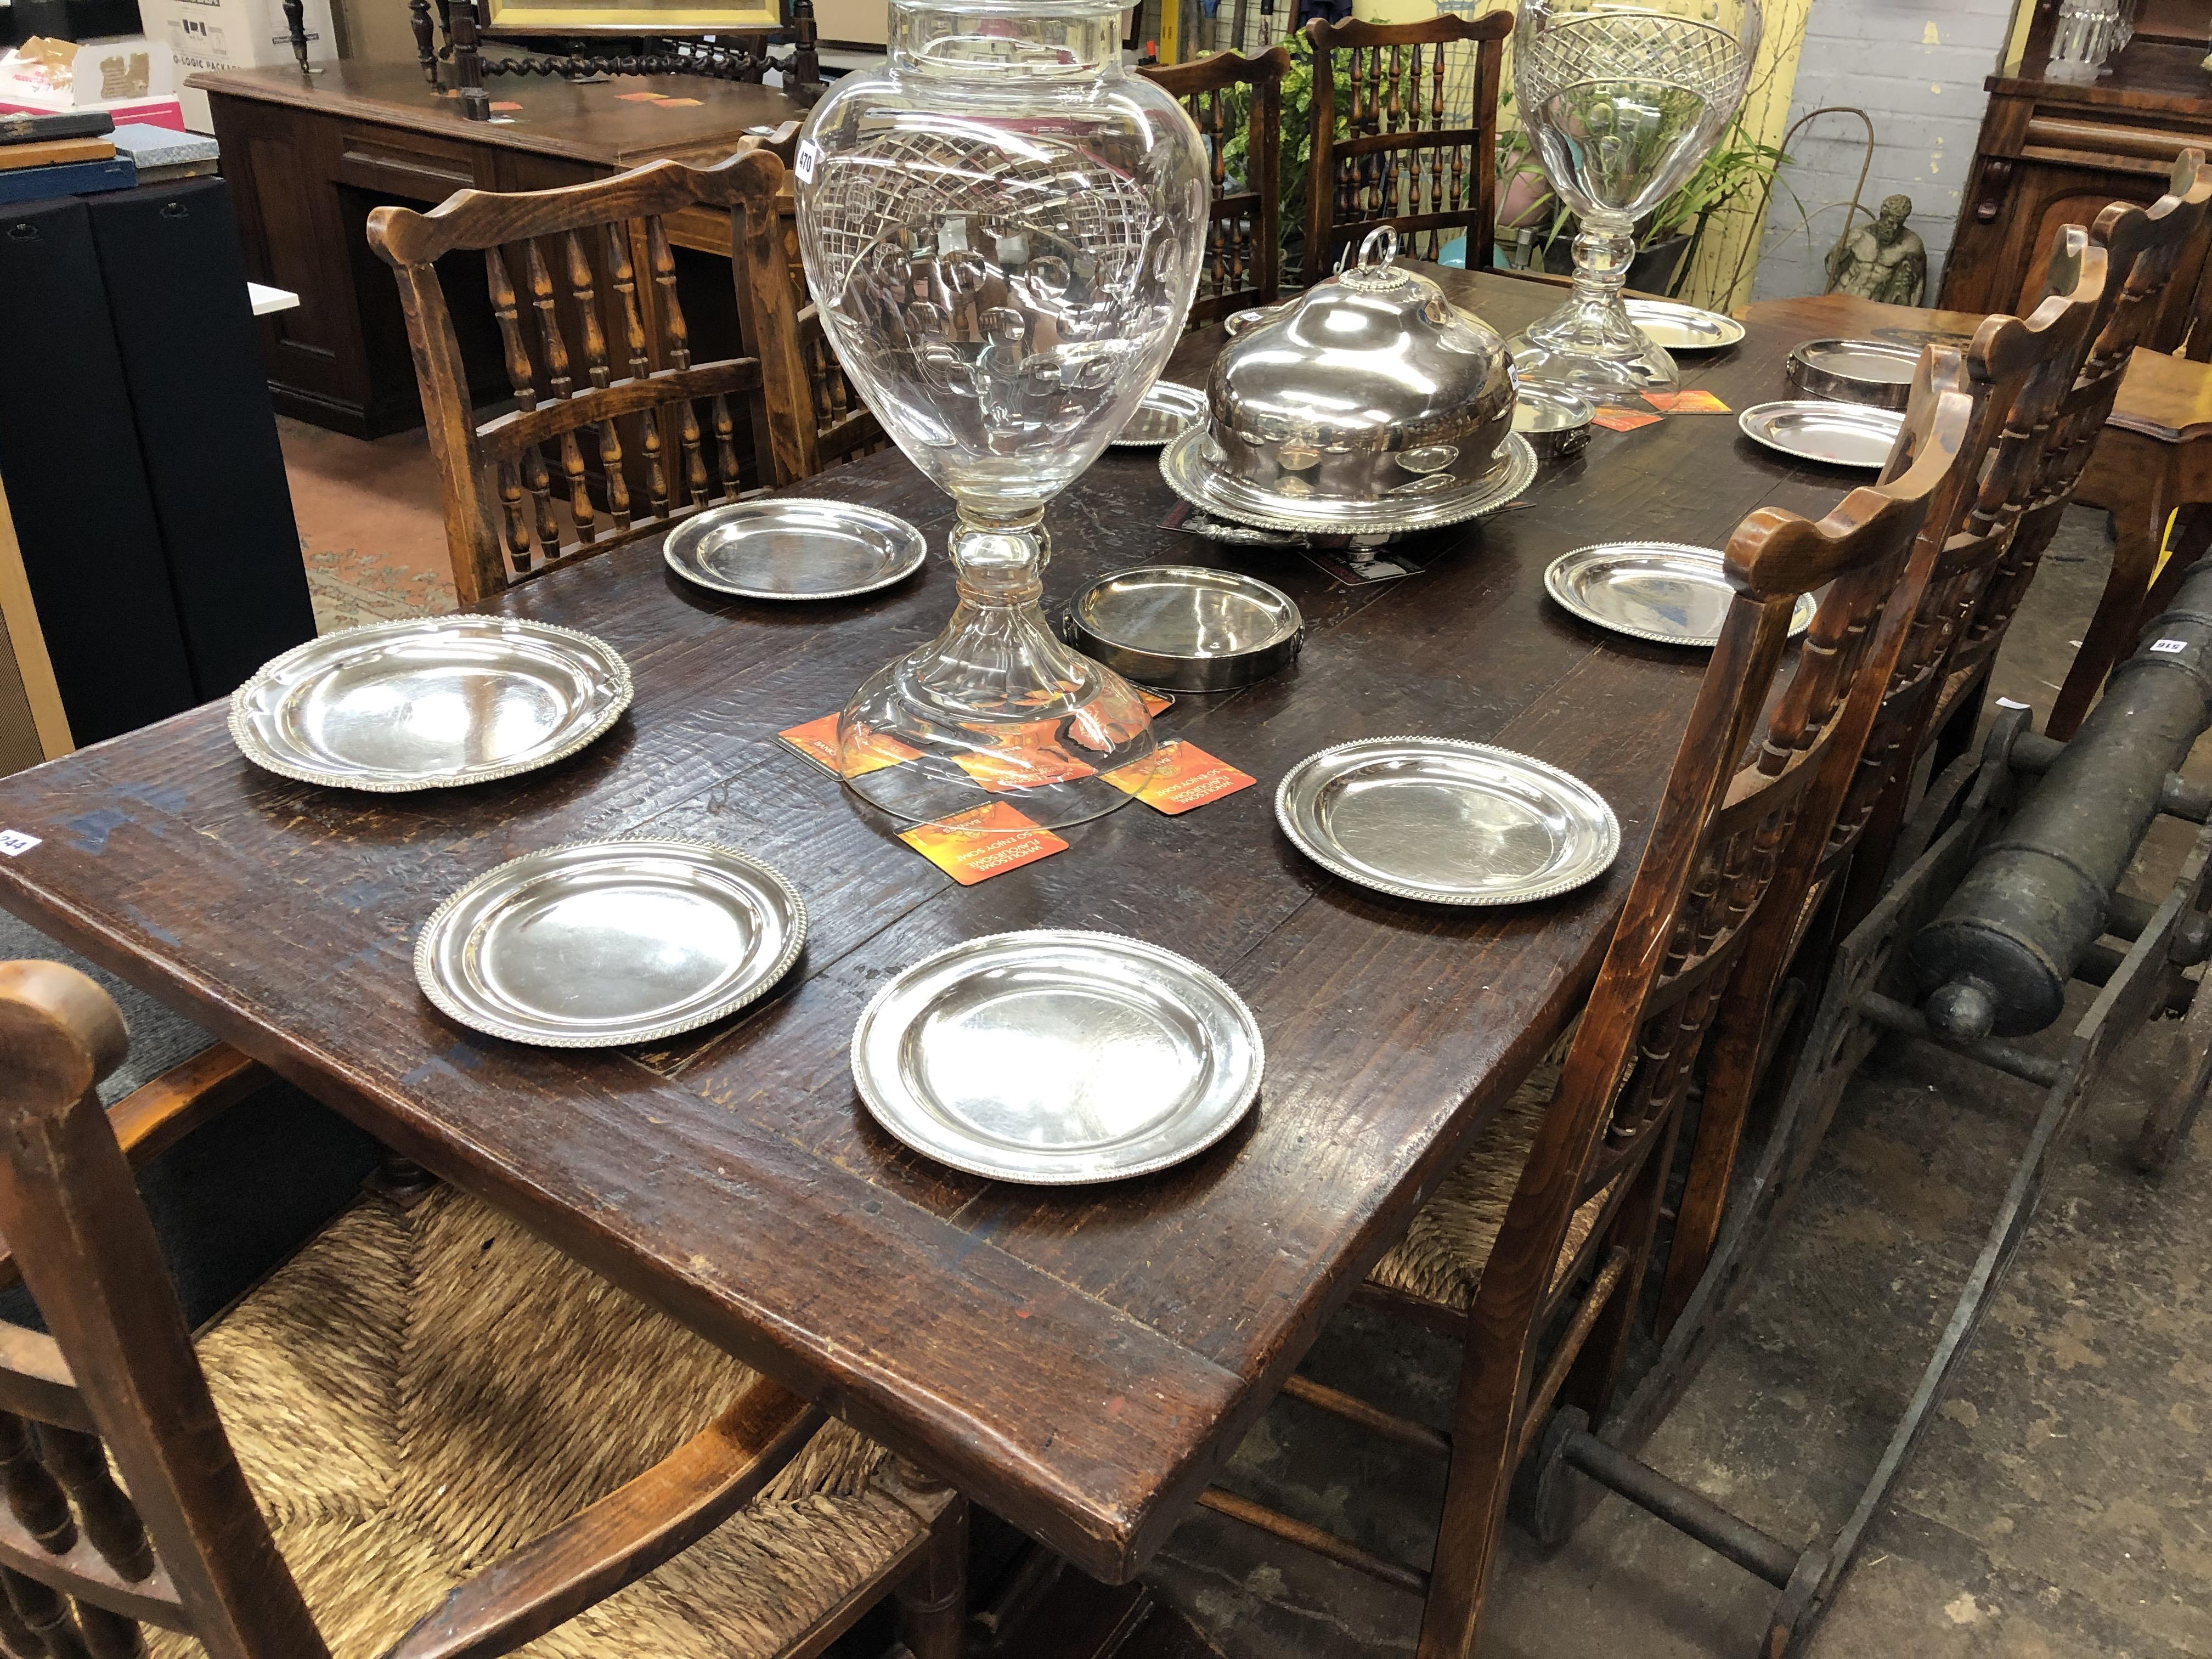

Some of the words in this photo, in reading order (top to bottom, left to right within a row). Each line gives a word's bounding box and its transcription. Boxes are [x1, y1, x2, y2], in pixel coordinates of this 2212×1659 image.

[206, 61, 241, 71] PACKA
[799, 151, 812, 173] 470
[1181, 774, 1207, 787] ENJOY
[1017, 831, 1032, 839] SO
[986, 837, 1017, 851] ENJOY
[955, 848, 986, 862] SOME
